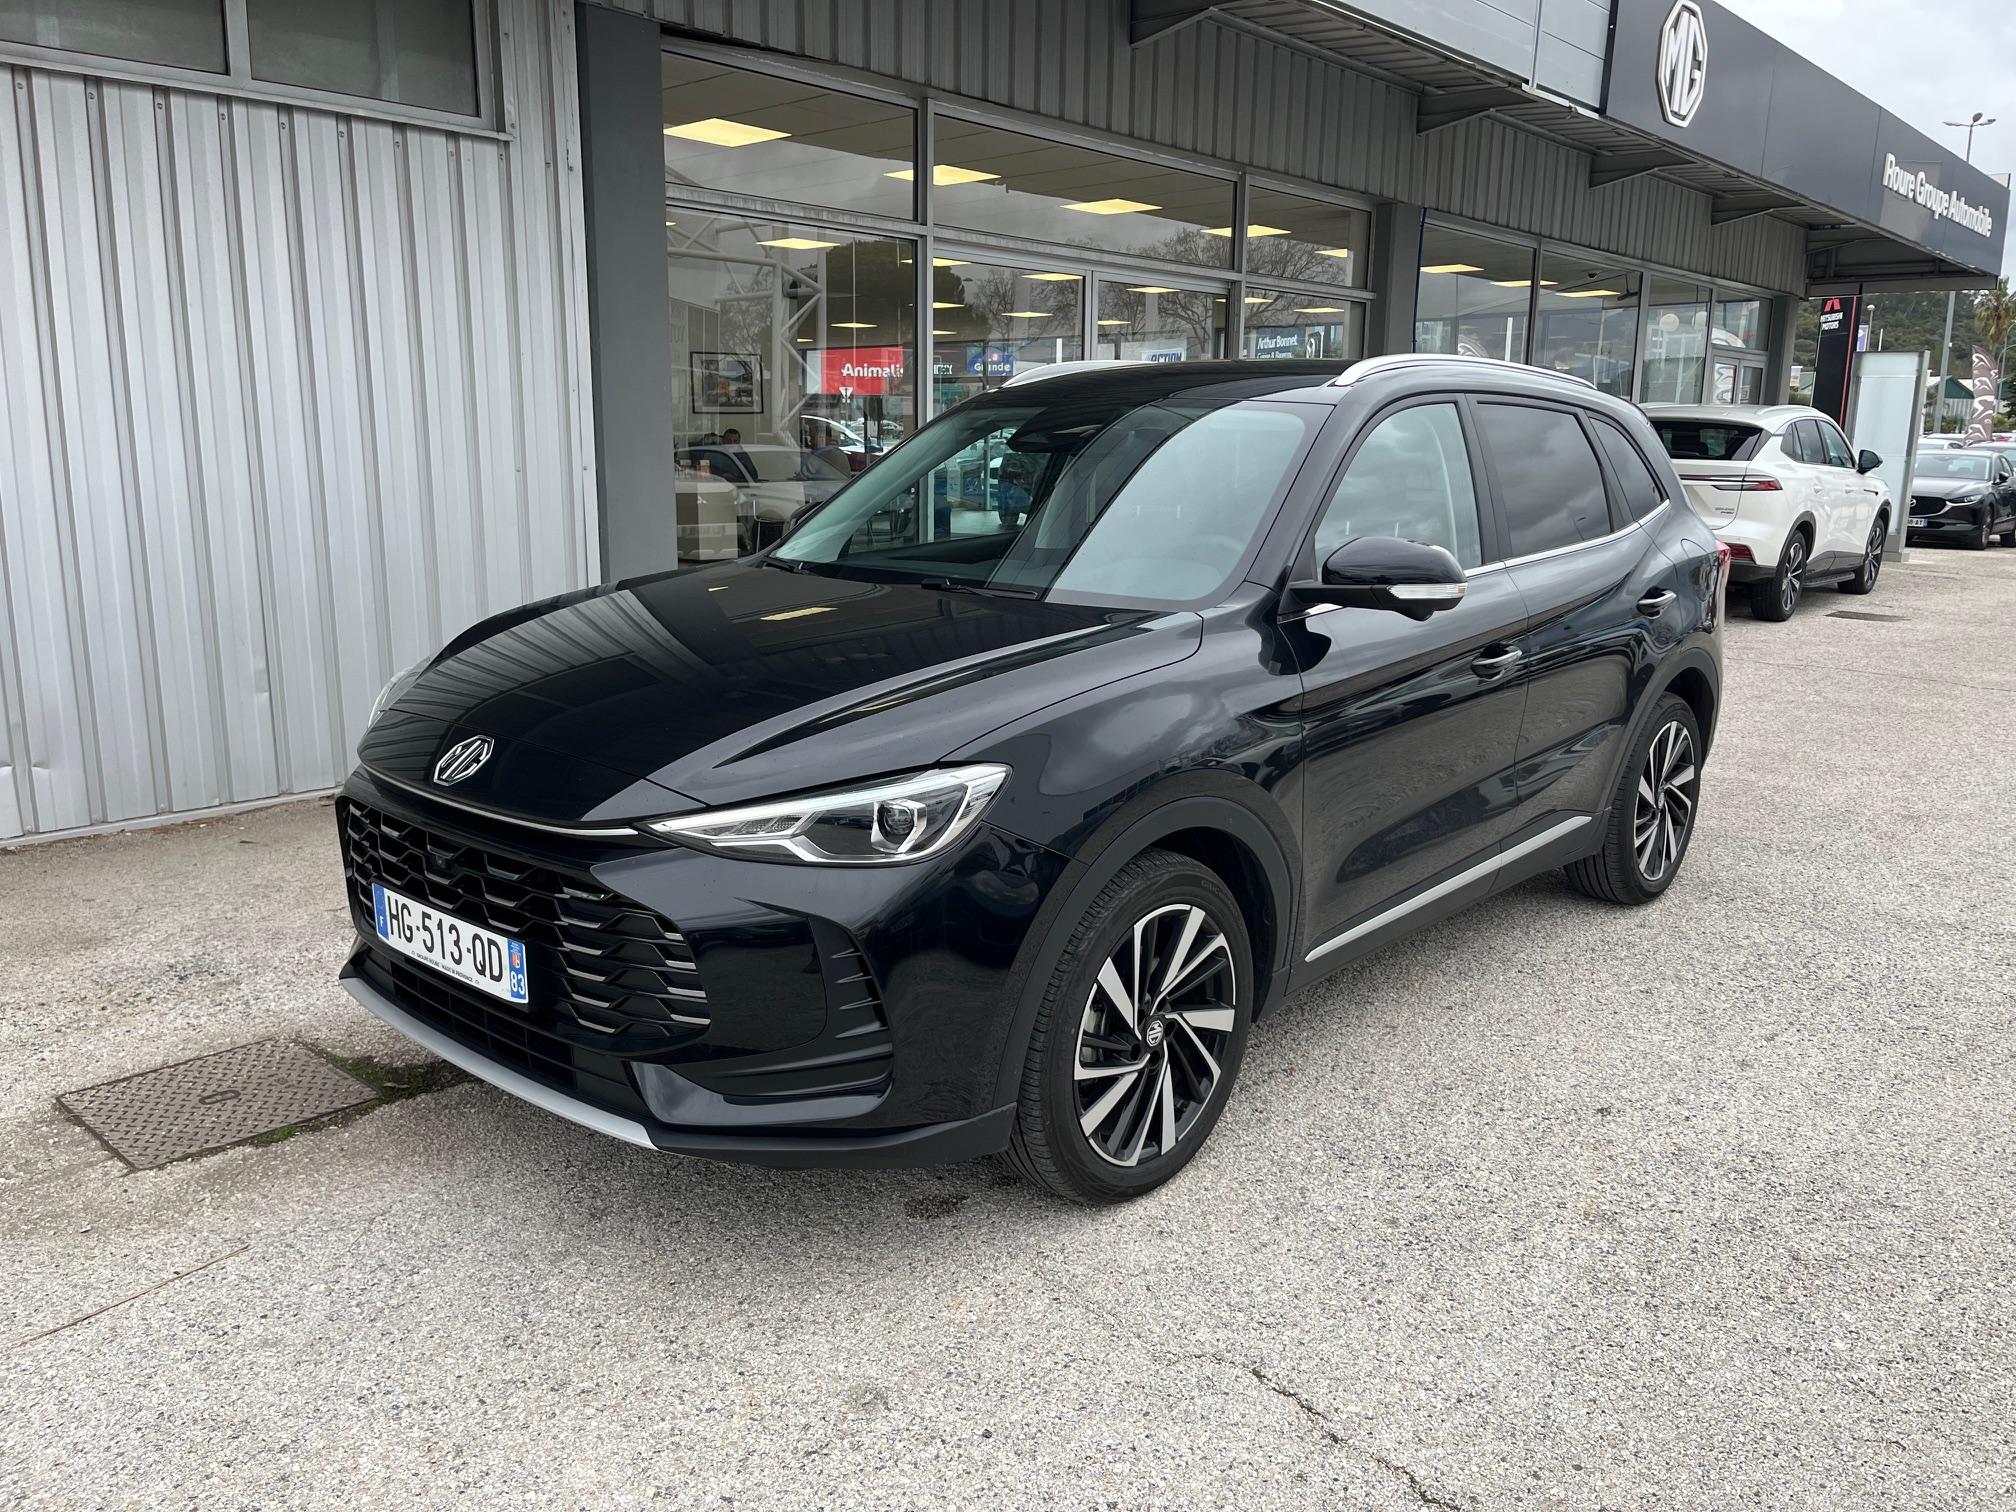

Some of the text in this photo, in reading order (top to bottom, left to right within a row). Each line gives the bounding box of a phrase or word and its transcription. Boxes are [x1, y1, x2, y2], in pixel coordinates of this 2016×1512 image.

[1663, 9, 1705, 117] MG
[1883, 153, 1992, 237] Roure Groupe Automobile
[1257, 334, 1298, 350] Arthur Bonnet
[438, 738, 490, 782] MG
[387, 895, 503, 982] HG-513-QD
[510, 970, 526, 995] 83
